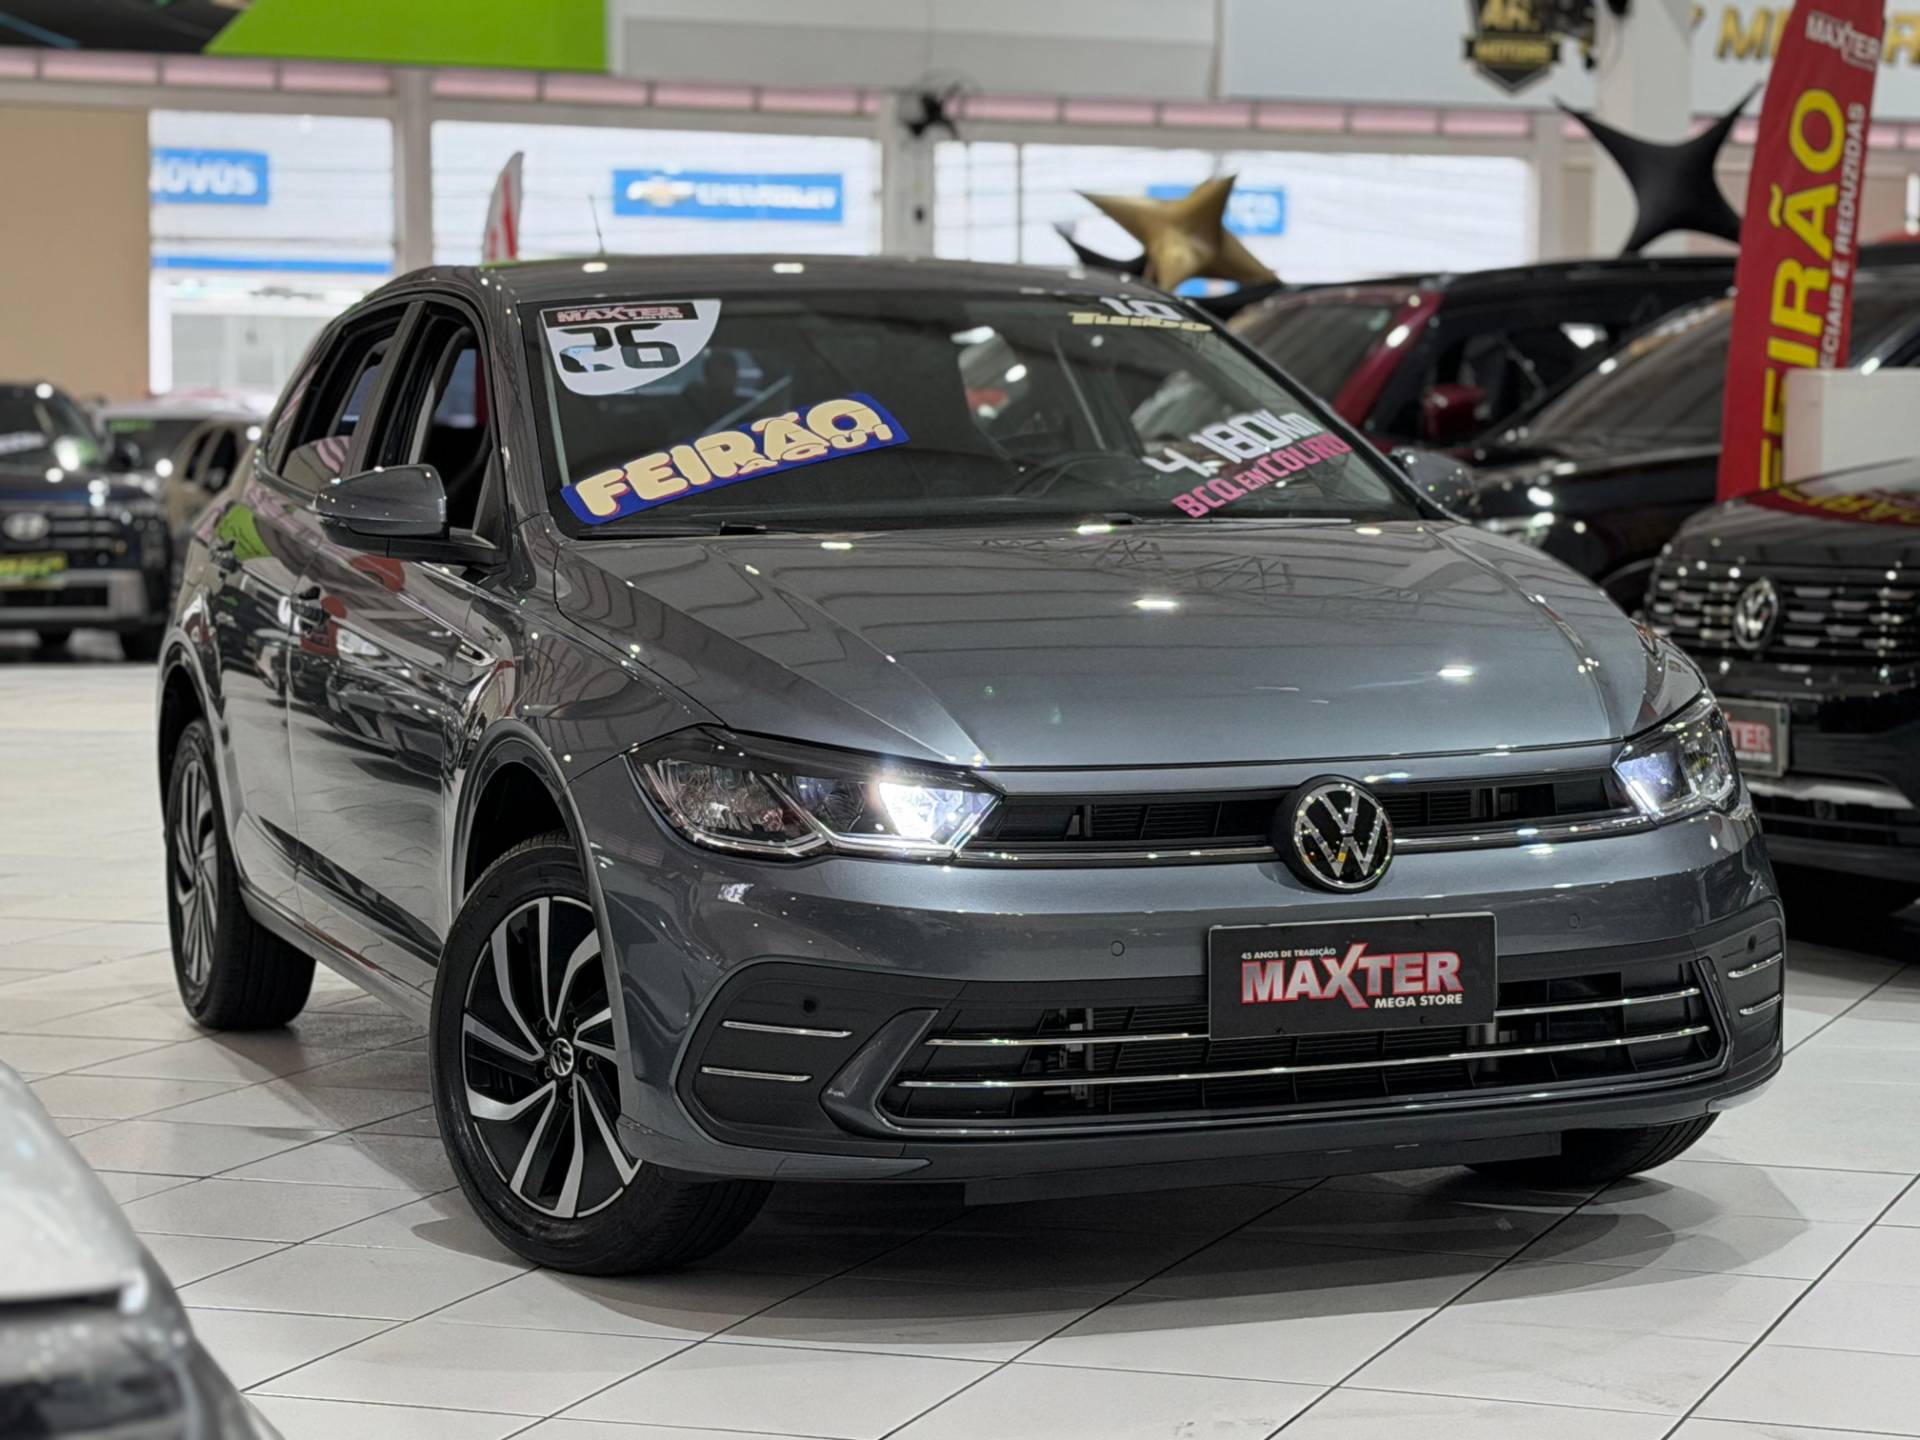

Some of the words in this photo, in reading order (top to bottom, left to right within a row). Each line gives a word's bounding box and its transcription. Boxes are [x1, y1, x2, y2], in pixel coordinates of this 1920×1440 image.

[1805, 10, 1881, 63] MAXTER
[556, 306, 683, 323] MAXTER
[558, 322, 682, 374] 26
[575, 398, 883, 517] FEIRÃO
[1241, 942, 1464, 1009] MAXTER
[1253, 950, 1279, 960] ANOS
[1280, 949, 1293, 958] DE
[1294, 947, 1337, 958] TRADIÇÃO
[1374, 996, 1416, 1009] MEGA
[1419, 994, 1463, 1006] STORE
